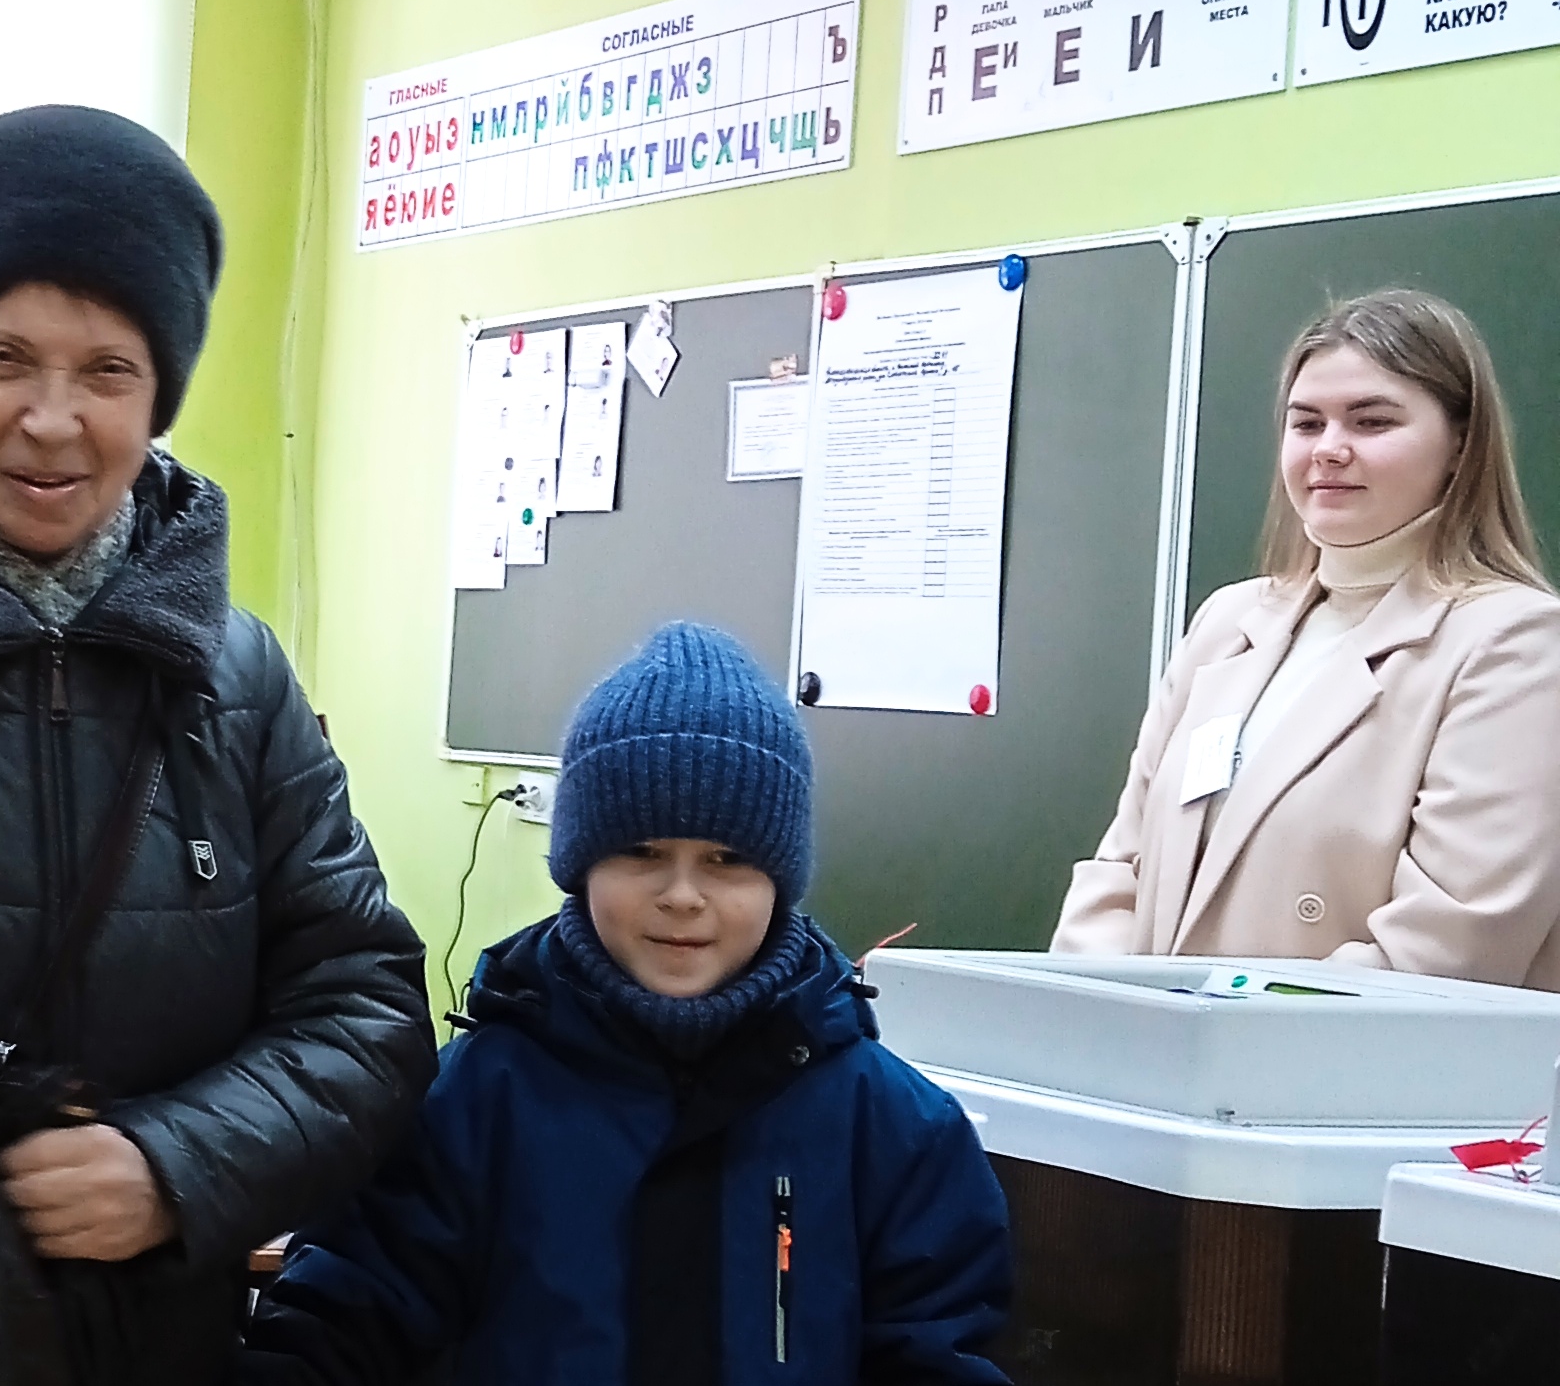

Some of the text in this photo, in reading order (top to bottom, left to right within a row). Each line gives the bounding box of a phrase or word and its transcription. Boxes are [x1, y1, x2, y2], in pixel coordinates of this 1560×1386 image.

[1209, 4, 1249, 23] МЕСТА
[1424, 0, 1508, 34] КАКУЮ?
[602, 14, 695, 53] СОГЛАСНЫЕ
[389, 77, 449, 106] ГЛАСНЫЕ
